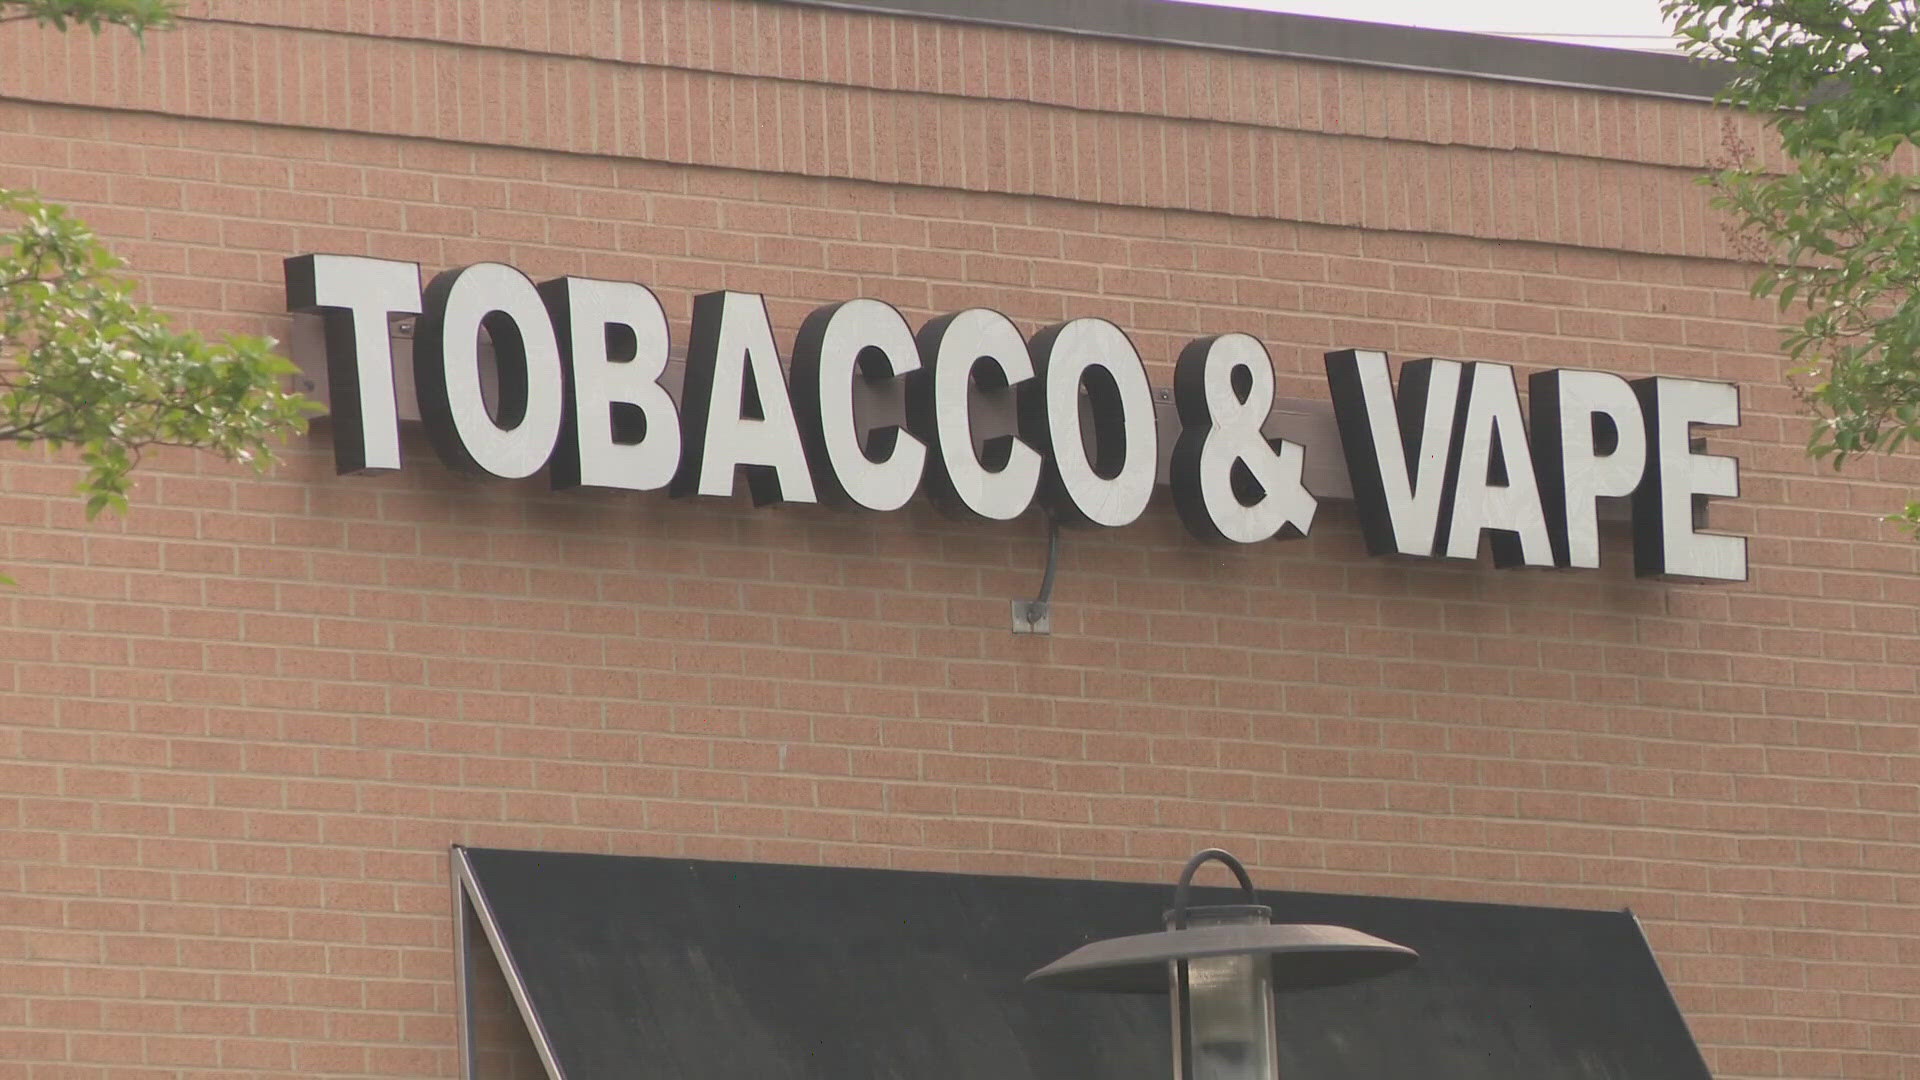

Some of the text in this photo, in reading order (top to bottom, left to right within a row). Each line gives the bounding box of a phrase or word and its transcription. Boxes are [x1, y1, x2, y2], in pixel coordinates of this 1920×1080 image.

[308, 254, 1748, 581] TOBACCO & VAPE
